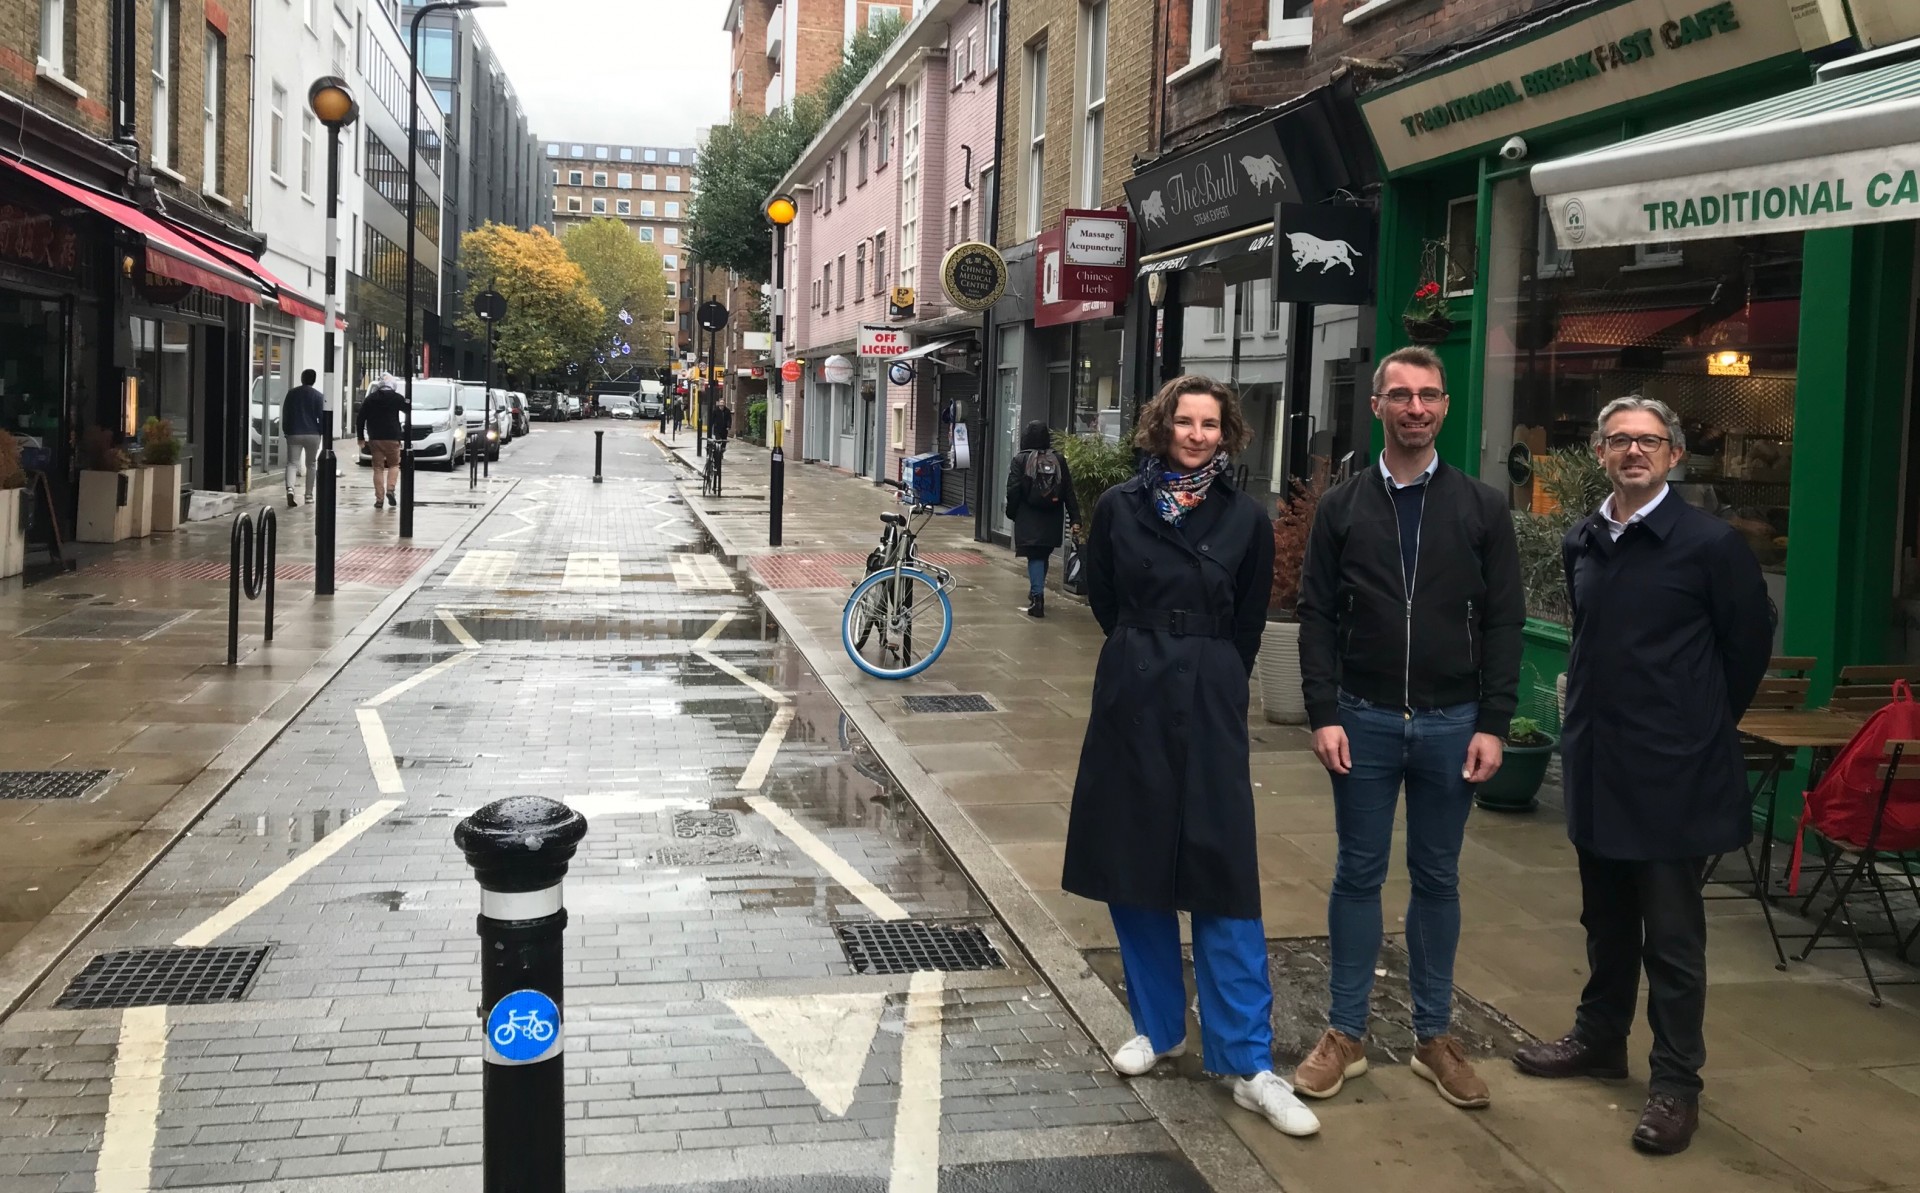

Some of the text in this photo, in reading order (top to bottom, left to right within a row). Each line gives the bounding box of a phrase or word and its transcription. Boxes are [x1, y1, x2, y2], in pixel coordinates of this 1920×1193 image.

[1400, 1, 1740, 137] TRADITIONAL BREAKFAST CAFE
[1167, 153, 1239, 215] The Bull
[1643, 178, 1853, 232] TRADITIONAL
[1193, 205, 1231, 226] STEAK EXPERT
[1080, 229, 1115, 240] Massage
[1069, 242, 1122, 252] Acupuncture
[960, 264, 992, 276] CHINESE
[959, 271, 992, 283] MEDICAL
[1076, 271, 1114, 282] Chinese
[960, 279, 989, 291] CENTRE
[1081, 284, 1108, 294] Herbs
[875, 333, 897, 343] OFF
